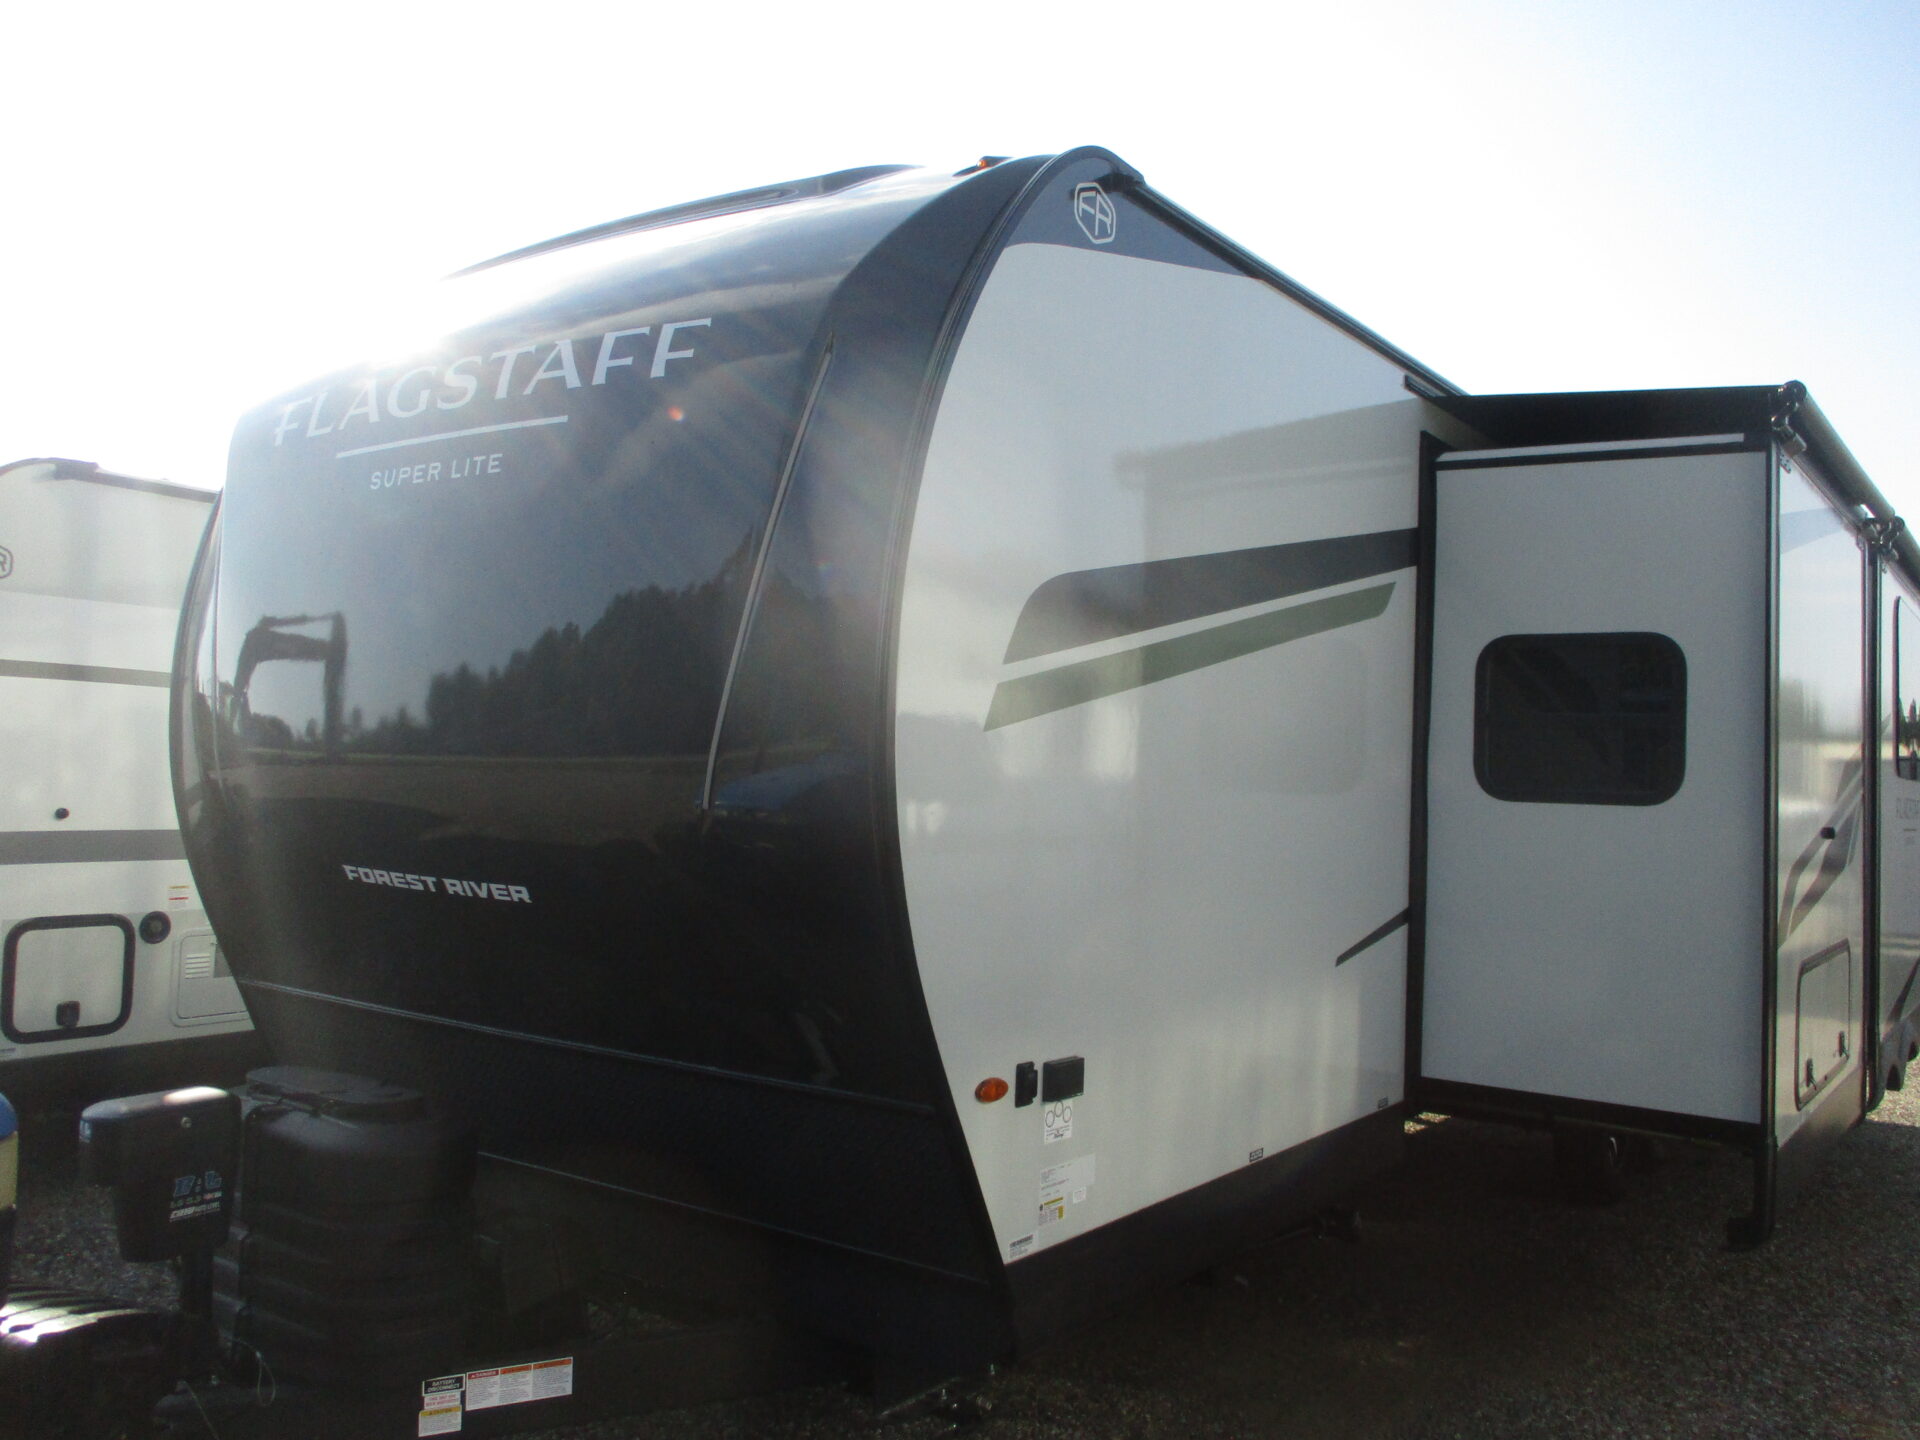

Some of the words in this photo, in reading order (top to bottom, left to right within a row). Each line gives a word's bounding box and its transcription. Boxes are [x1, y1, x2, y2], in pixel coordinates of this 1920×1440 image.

[274, 318, 711, 446] FLAGSTAFF
[370, 462, 440, 490] SUPER
[450, 454, 503, 479] LITE
[342, 865, 436, 892] FOREST
[442, 878, 532, 903] RIVER
